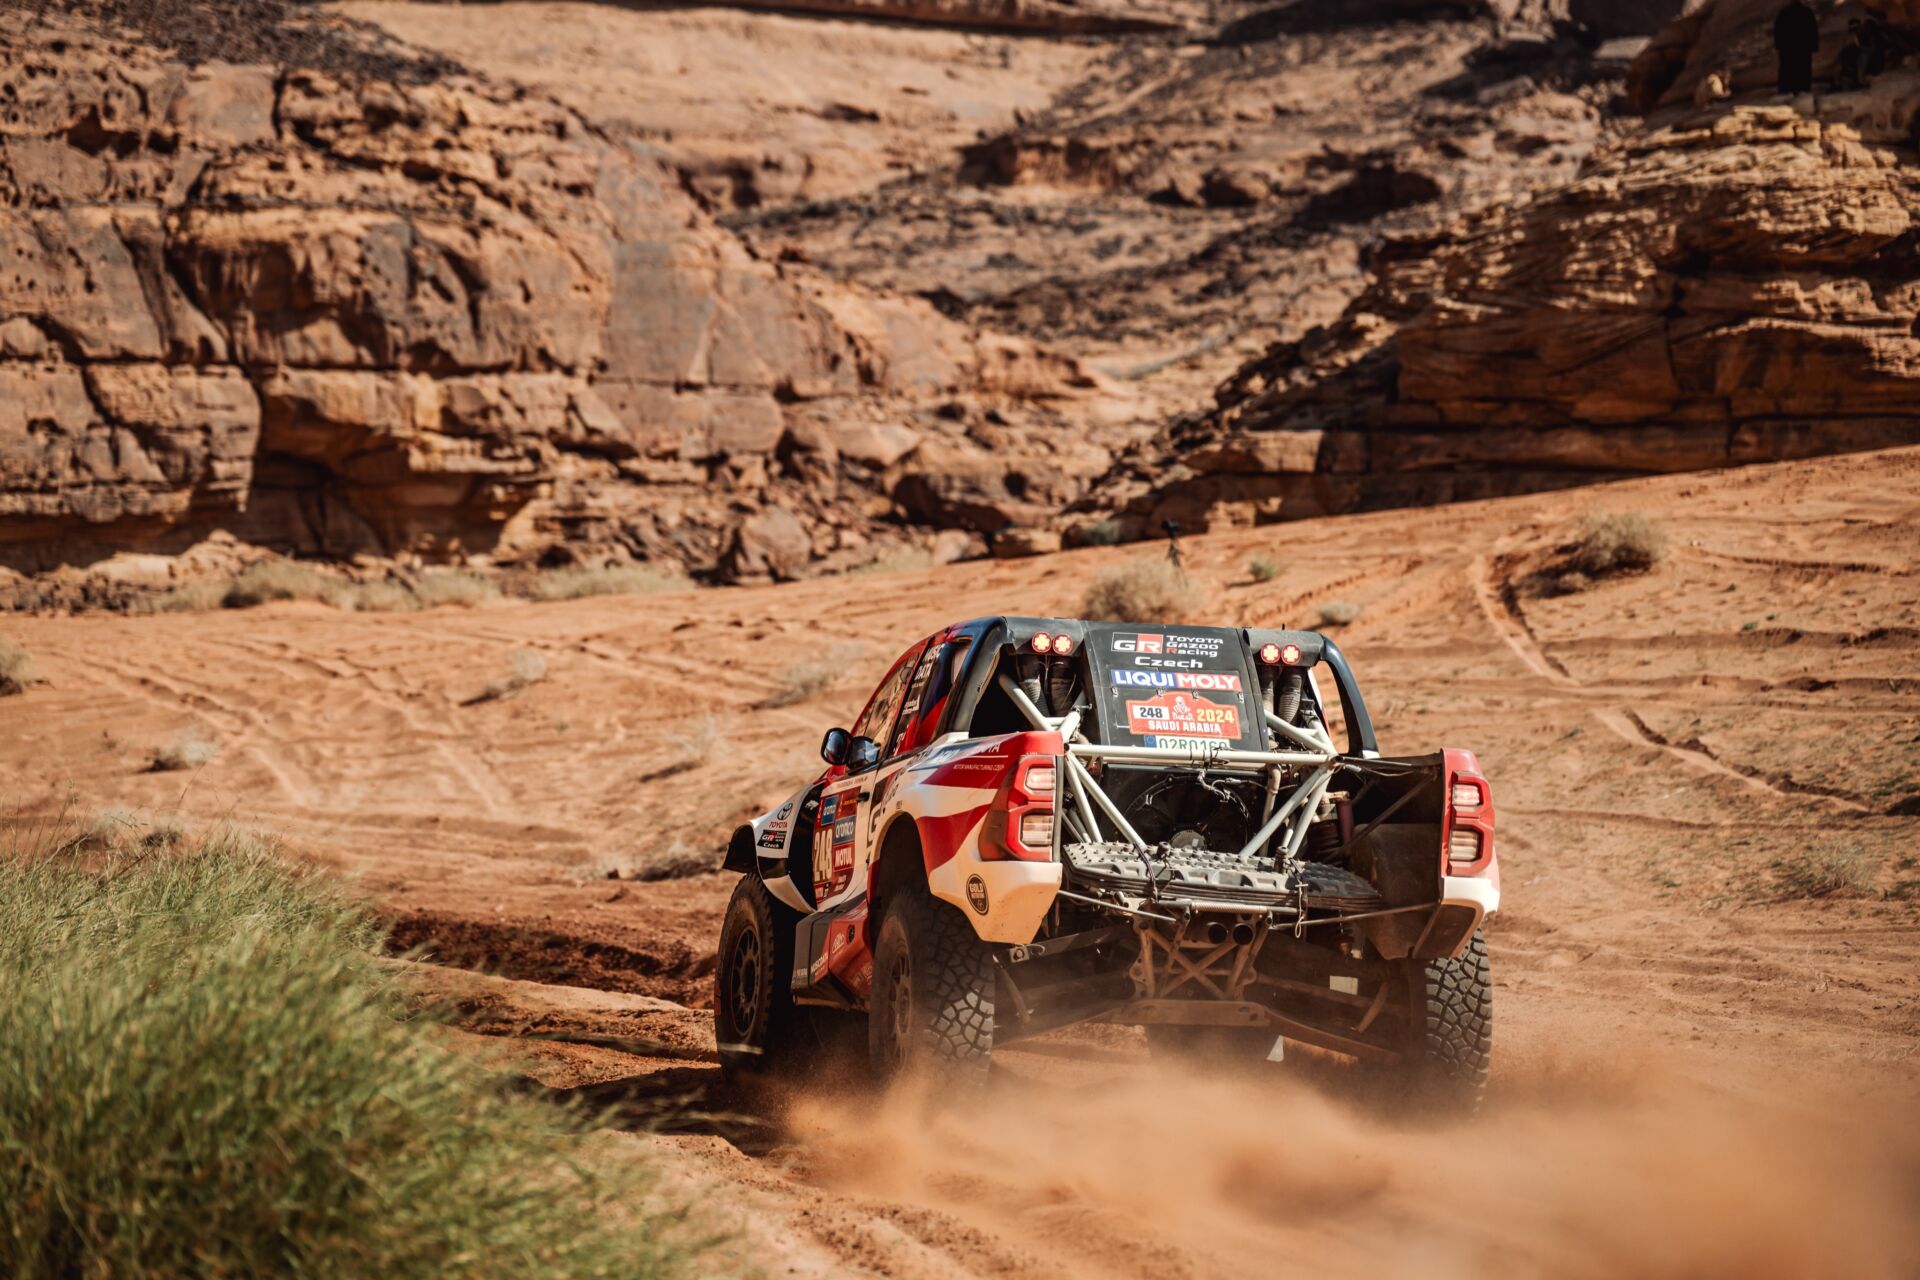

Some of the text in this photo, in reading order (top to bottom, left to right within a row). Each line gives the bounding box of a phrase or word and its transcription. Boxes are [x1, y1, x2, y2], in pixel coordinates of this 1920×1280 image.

[1113, 639, 1161, 653] GR
[1166, 635, 1224, 645] TOYOTA
[1166, 641, 1219, 650] GAZOO
[1166, 648, 1218, 657] Racing
[1134, 656, 1204, 668] Czech
[1114, 671, 1237, 689] LIQUI MOLY
[1139, 707, 1235, 723] 248 2024
[1148, 720, 1222, 733] SAUDI ARABIA
[814, 828, 833, 882] 248
[834, 847, 853, 868] MOTUL
[970, 883, 984, 893] GOLD
